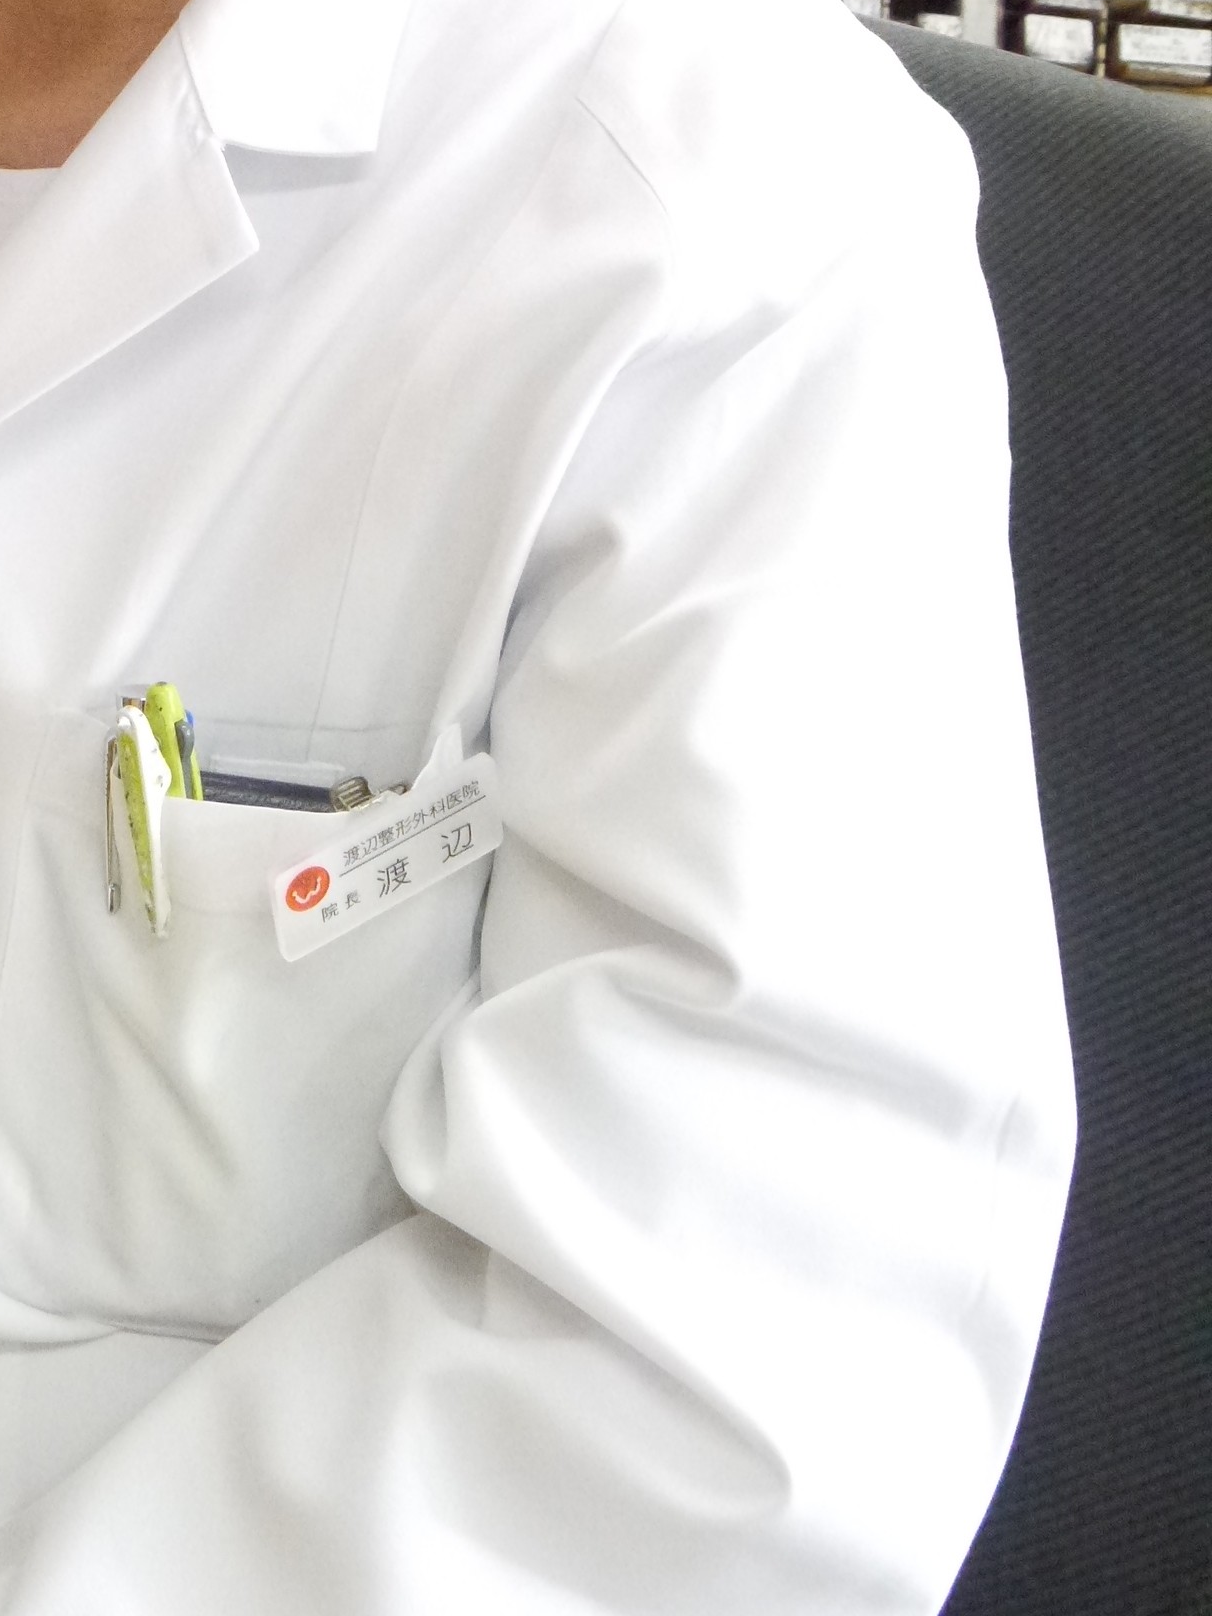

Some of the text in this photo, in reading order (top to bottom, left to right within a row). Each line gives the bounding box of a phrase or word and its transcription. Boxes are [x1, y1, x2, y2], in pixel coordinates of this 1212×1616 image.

[321, 814, 475, 923] 院長 渡辺
[343, 781, 481, 866] 渡辺整形外科医院
